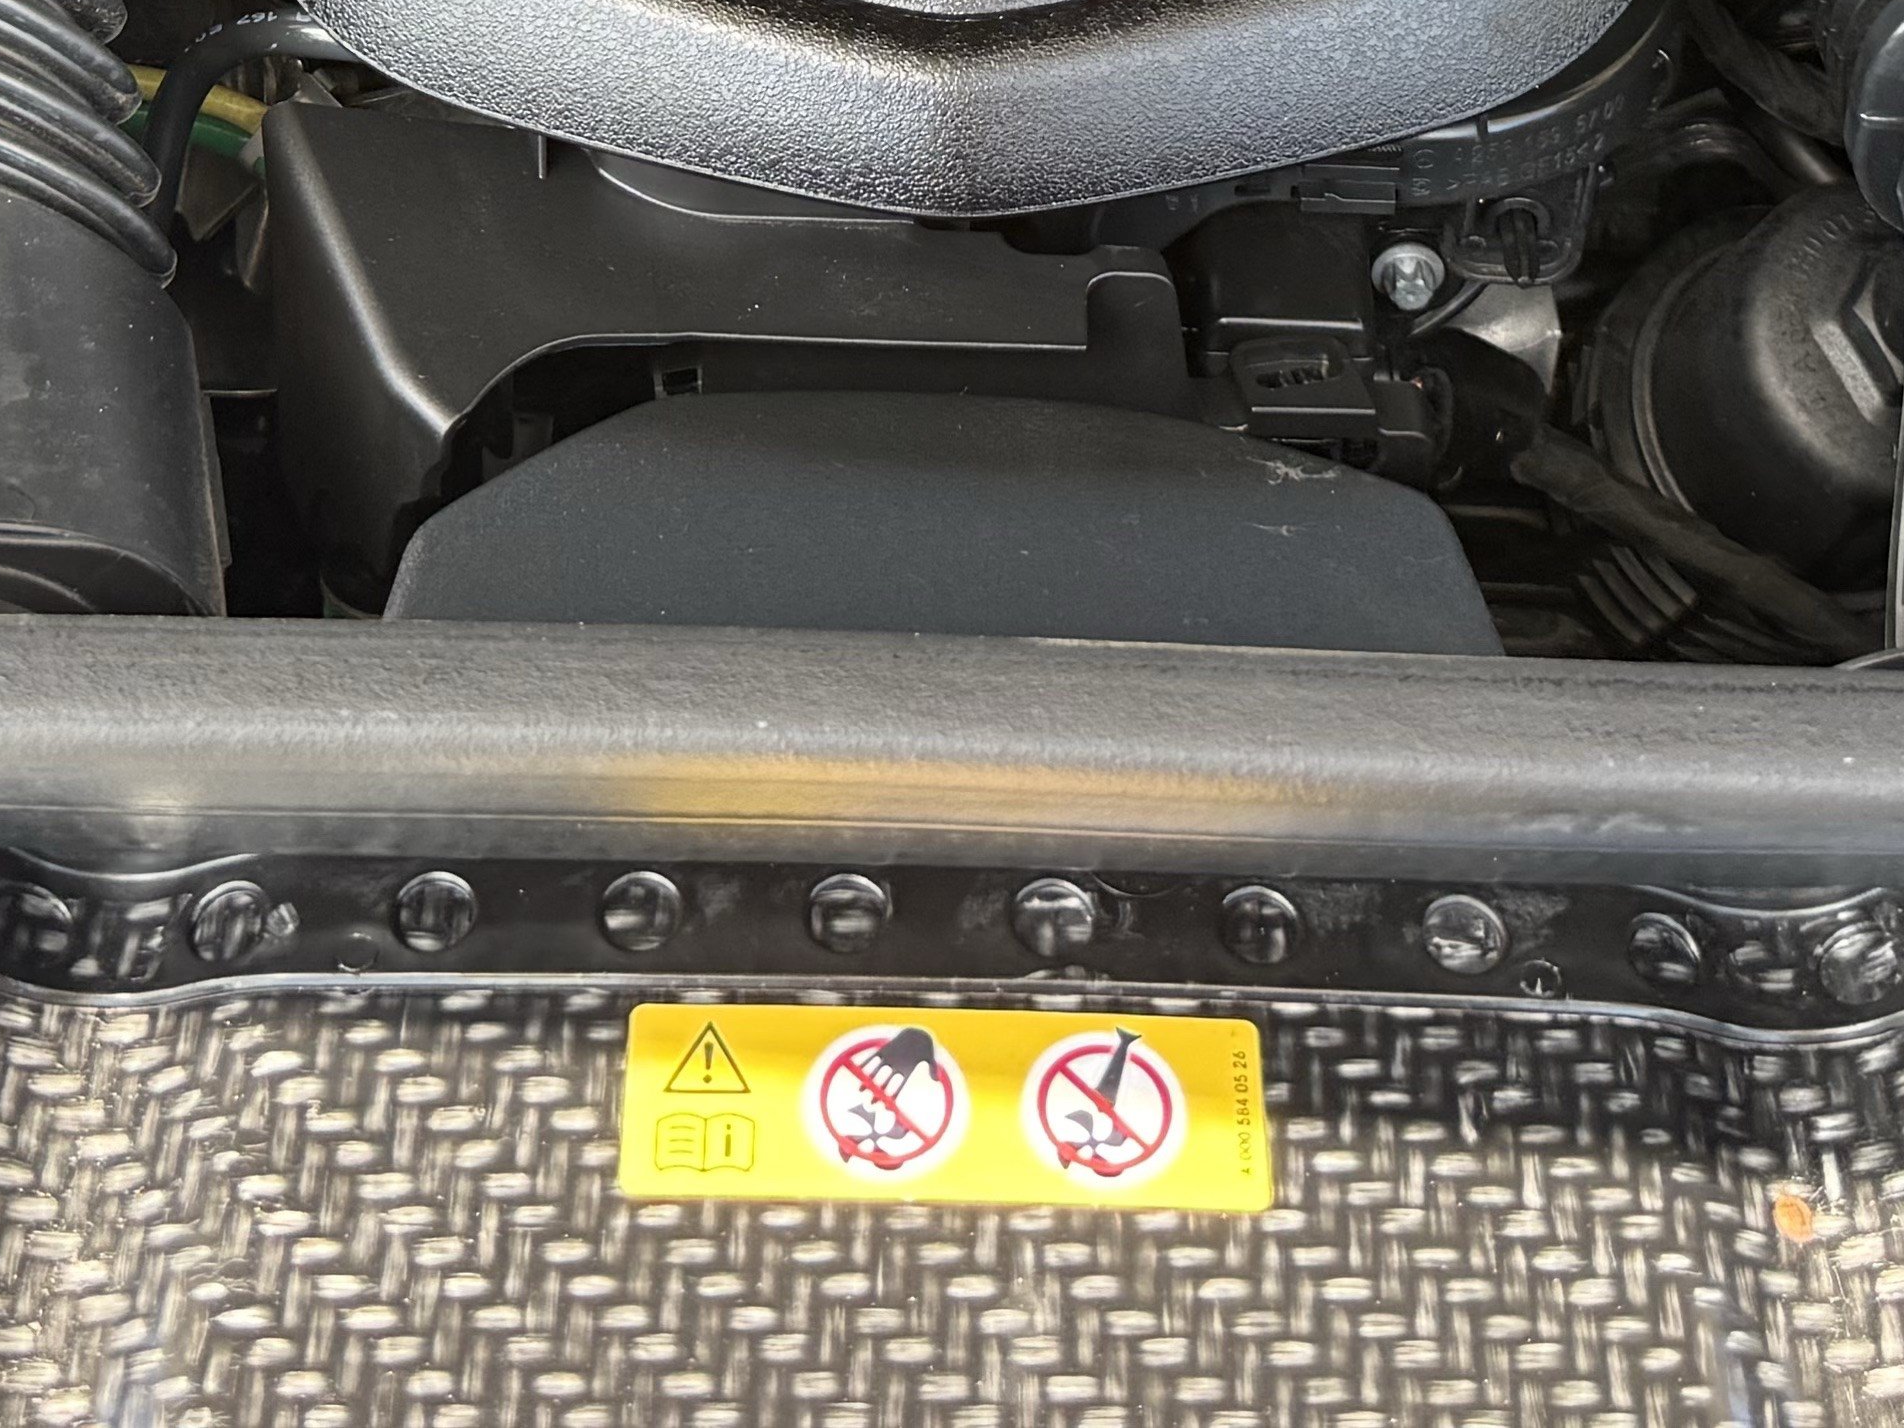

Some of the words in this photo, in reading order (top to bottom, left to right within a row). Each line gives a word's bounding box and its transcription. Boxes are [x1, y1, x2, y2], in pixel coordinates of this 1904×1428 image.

[1232, 1050, 1248, 1069] 26
[1234, 1074, 1249, 1093] 05
[1236, 1098, 1251, 1126] 584
